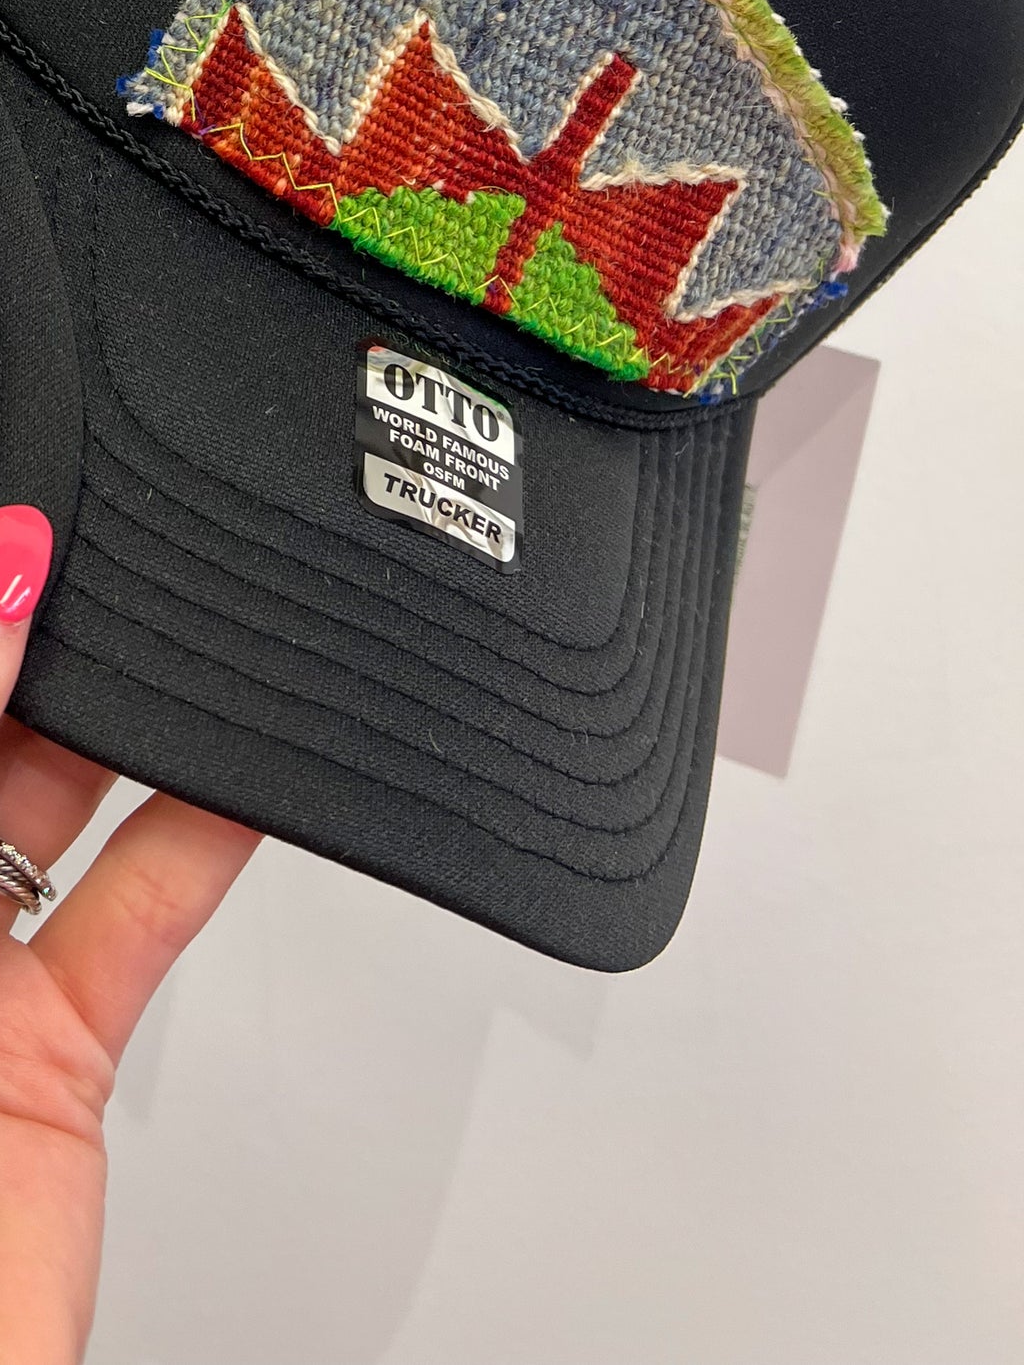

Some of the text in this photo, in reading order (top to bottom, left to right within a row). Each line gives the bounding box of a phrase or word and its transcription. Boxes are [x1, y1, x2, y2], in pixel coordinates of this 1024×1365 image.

[384, 363, 500, 442] OTTO
[372, 405, 510, 480] WORLD FAMOUS
[389, 428, 501, 491] FOAM FRONT
[423, 462, 466, 491] OSFM
[384, 473, 503, 544] TRUCKER
